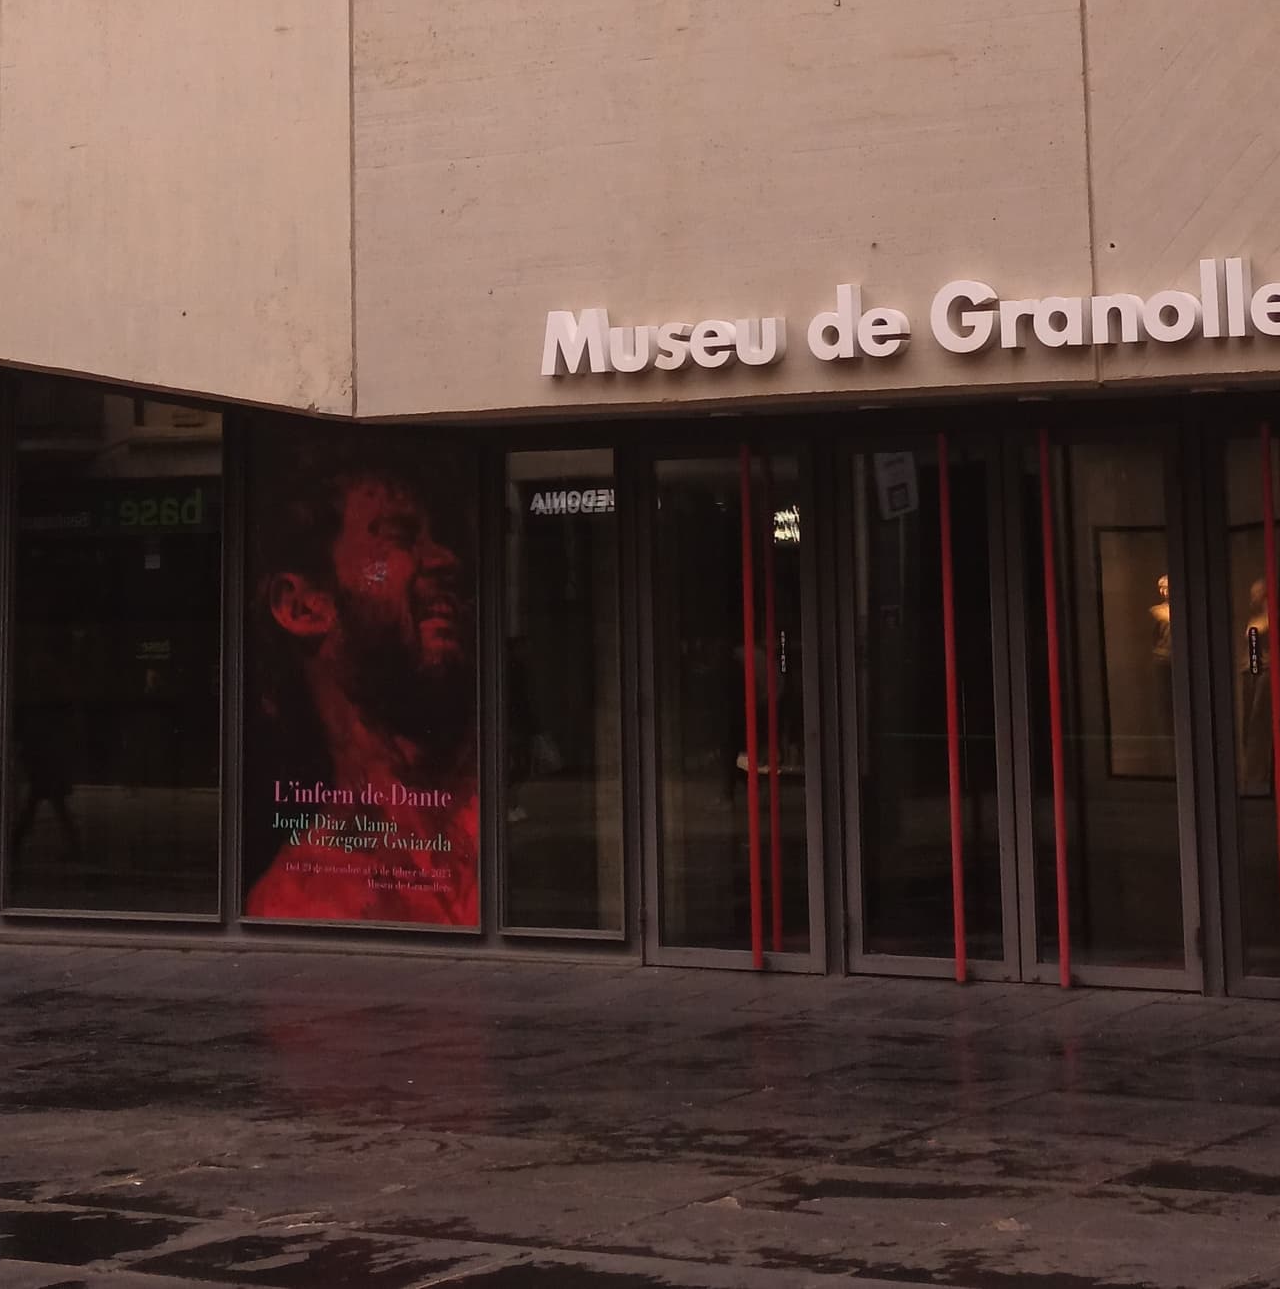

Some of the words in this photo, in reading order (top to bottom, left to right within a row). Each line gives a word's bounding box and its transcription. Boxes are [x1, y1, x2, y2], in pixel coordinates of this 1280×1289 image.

[541, 308, 787, 377] Museu
[807, 284, 912, 361] de
[274, 780, 354, 805] L'infern
[360, 783, 384, 806] de
[391, 784, 452, 808] Dante
[272, 812, 309, 831] Jordi
[289, 828, 303, 847] &
[307, 829, 379, 854] Grzegorz
[383, 832, 453, 853] Gwiazda
